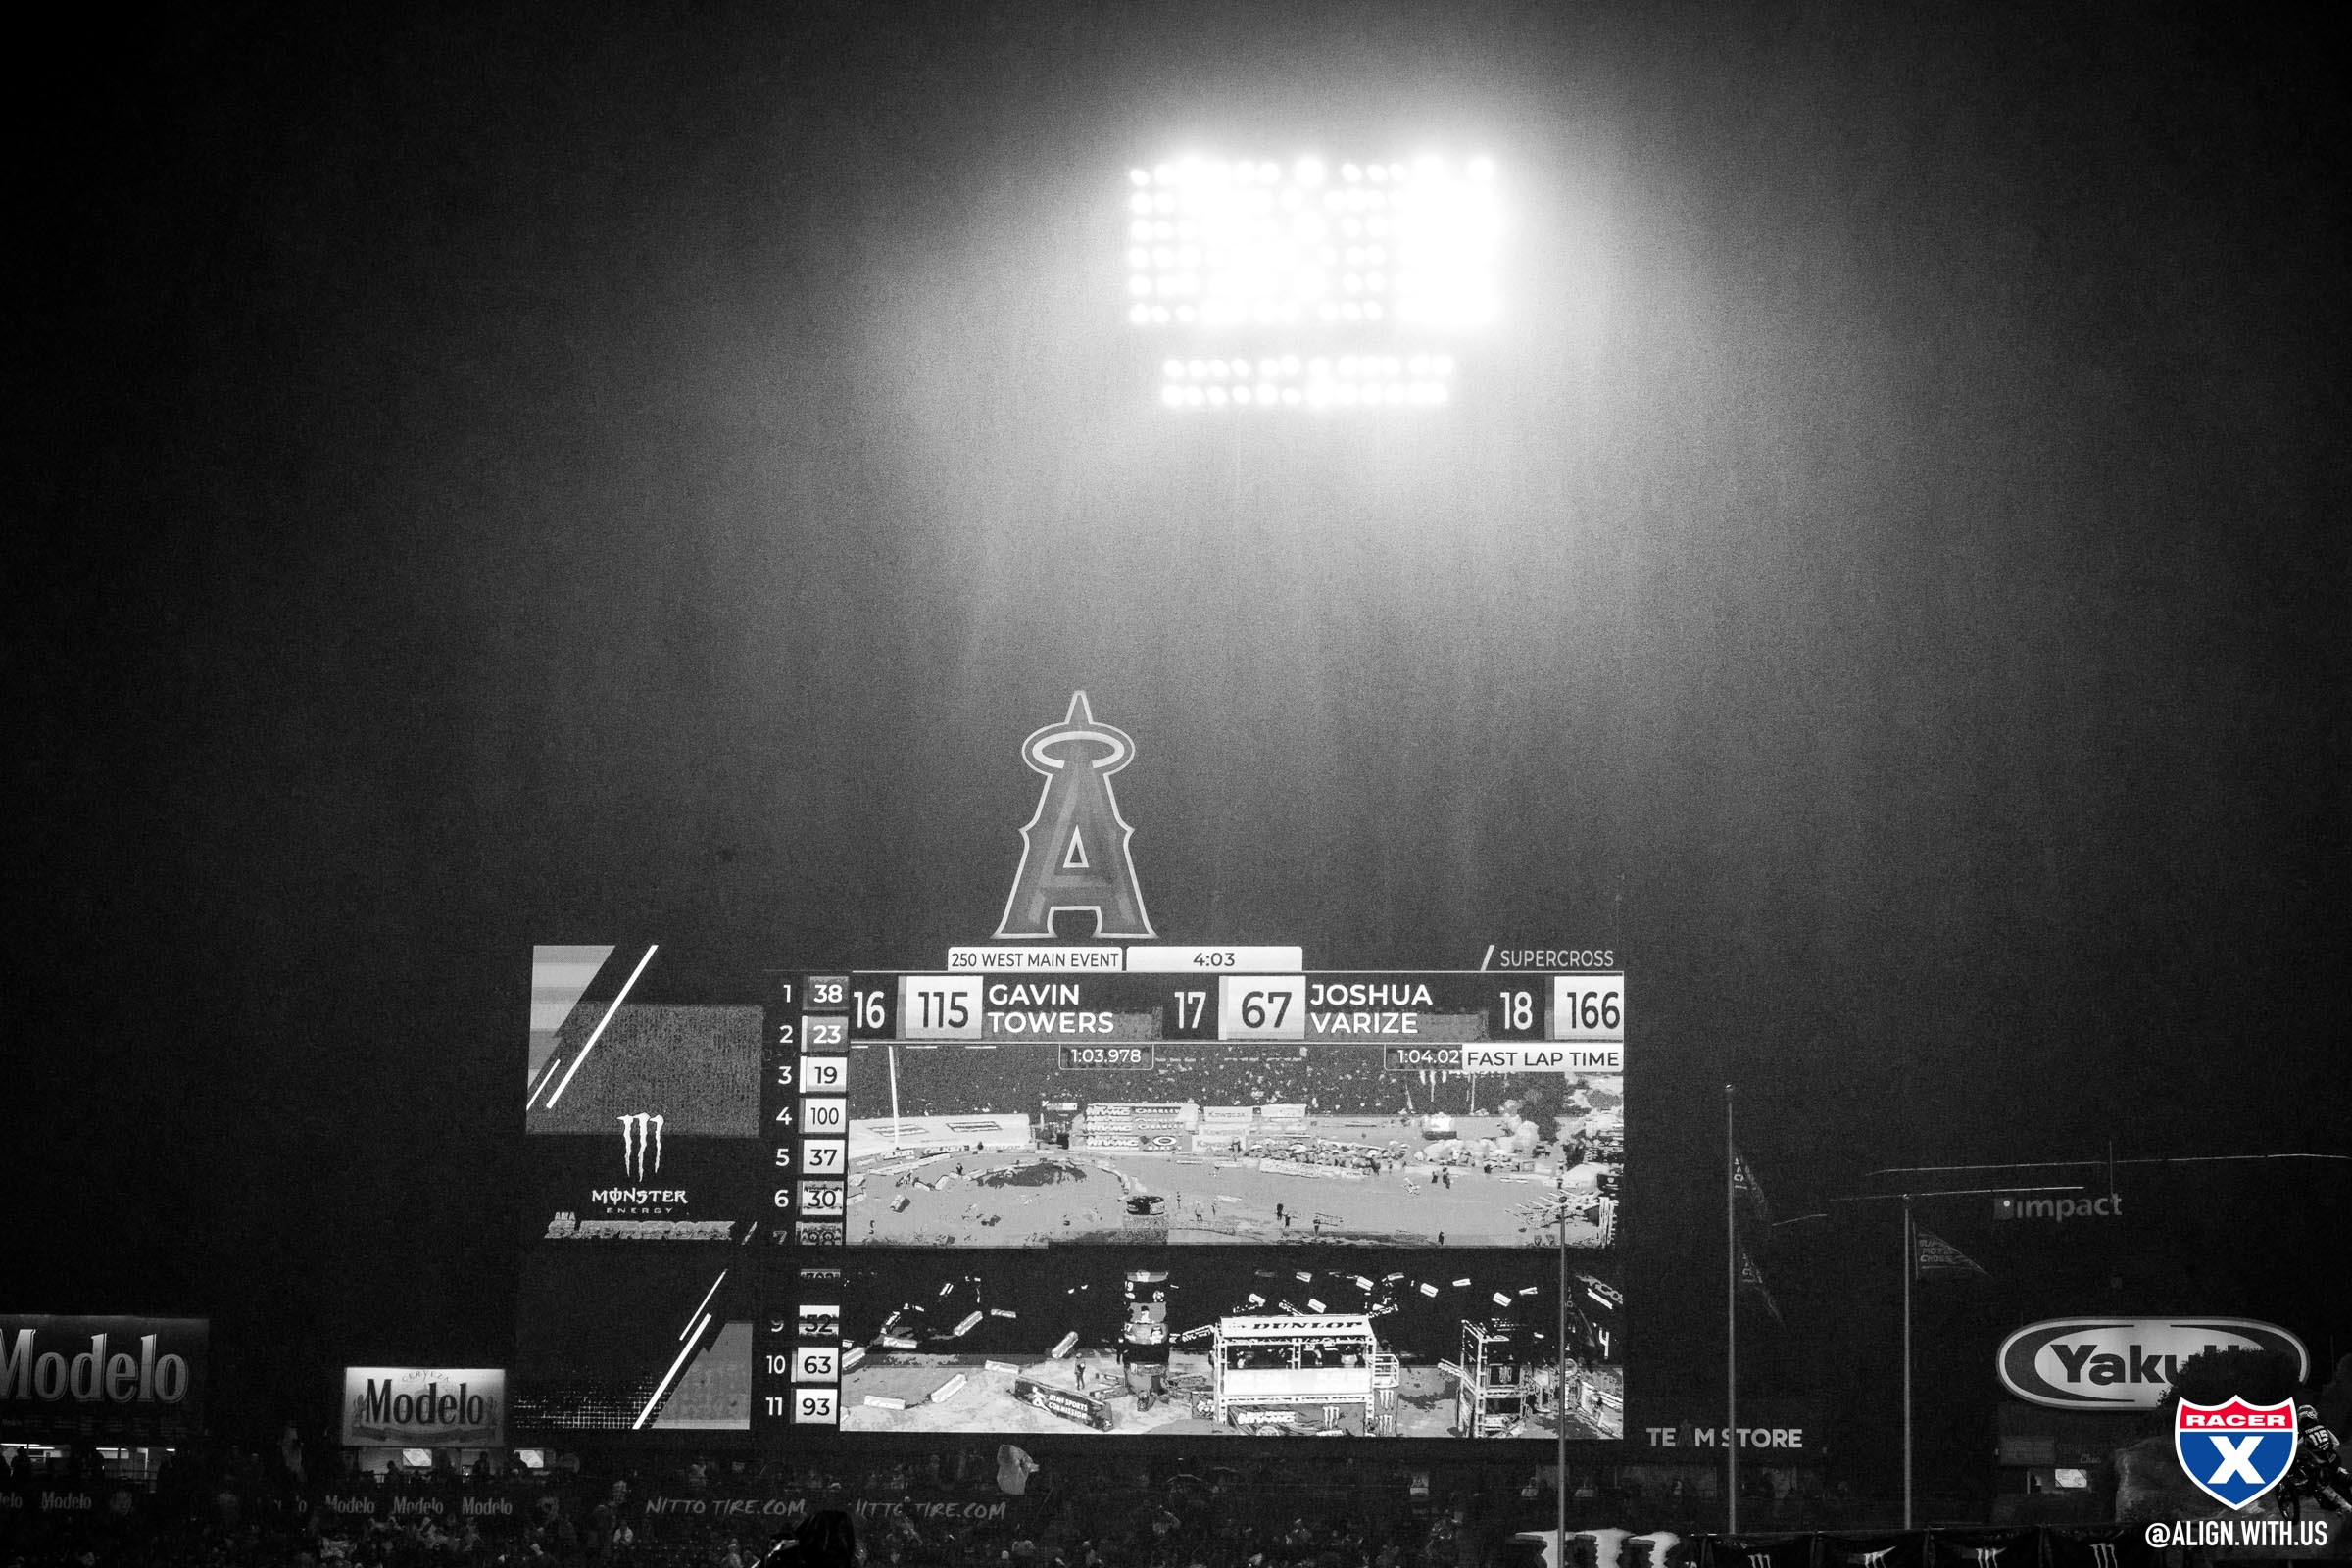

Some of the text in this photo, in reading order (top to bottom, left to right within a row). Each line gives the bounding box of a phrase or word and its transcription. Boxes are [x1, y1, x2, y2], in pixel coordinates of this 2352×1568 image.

[951, 953, 1119, 967] 250 WEST MAIN EVENT
[1193, 952, 1236, 967] 4:03
[1499, 950, 1615, 967] SUPERCROSS
[783, 984, 843, 1004] 1 38
[988, 984, 1080, 1005] GAVIN
[1310, 984, 1434, 1005] JOSHUA
[854, 991, 968, 1029] 16 115
[1175, 991, 1293, 1029] 17 67
[1499, 991, 1621, 1030] 18 166
[987, 1011, 1115, 1034] TOWERS
[1310, 1012, 1419, 1034] VARIZE
[779, 1024, 842, 1044] 2 23
[1070, 1048, 1142, 1063] 1:03.978
[1396, 1049, 1463, 1065] 1:04.02
[1467, 1052, 1620, 1066] FAST LAP TIME
[777, 1065, 838, 1085] 3 19
[775, 1106, 840, 1125] 4 100
[775, 1148, 838, 1166] 5 37
[591, 1187, 689, 1206] MONSTER
[774, 1189, 837, 1208] 6 30
[766, 1355, 832, 1374] 10 63
[2050, 1344, 2240, 1386] Yaku
[402, 1370, 450, 1383] CERVEZA
[366, 1378, 484, 1426] Modelo
[765, 1397, 830, 1416] 11 93
[1064, 1398, 1089, 1412] SPORTS
[1721, 1427, 1803, 1448] STORE
[2308, 1430, 2328, 1446] 115
[41, 1490, 93, 1511] Modelo
[393, 1495, 444, 1515] Modelo
[462, 1495, 514, 1516] Modelo
[645, 1496, 806, 1517] NITTO TIRE.COM
[914, 1501, 1007, 1520] TIRE.COM
